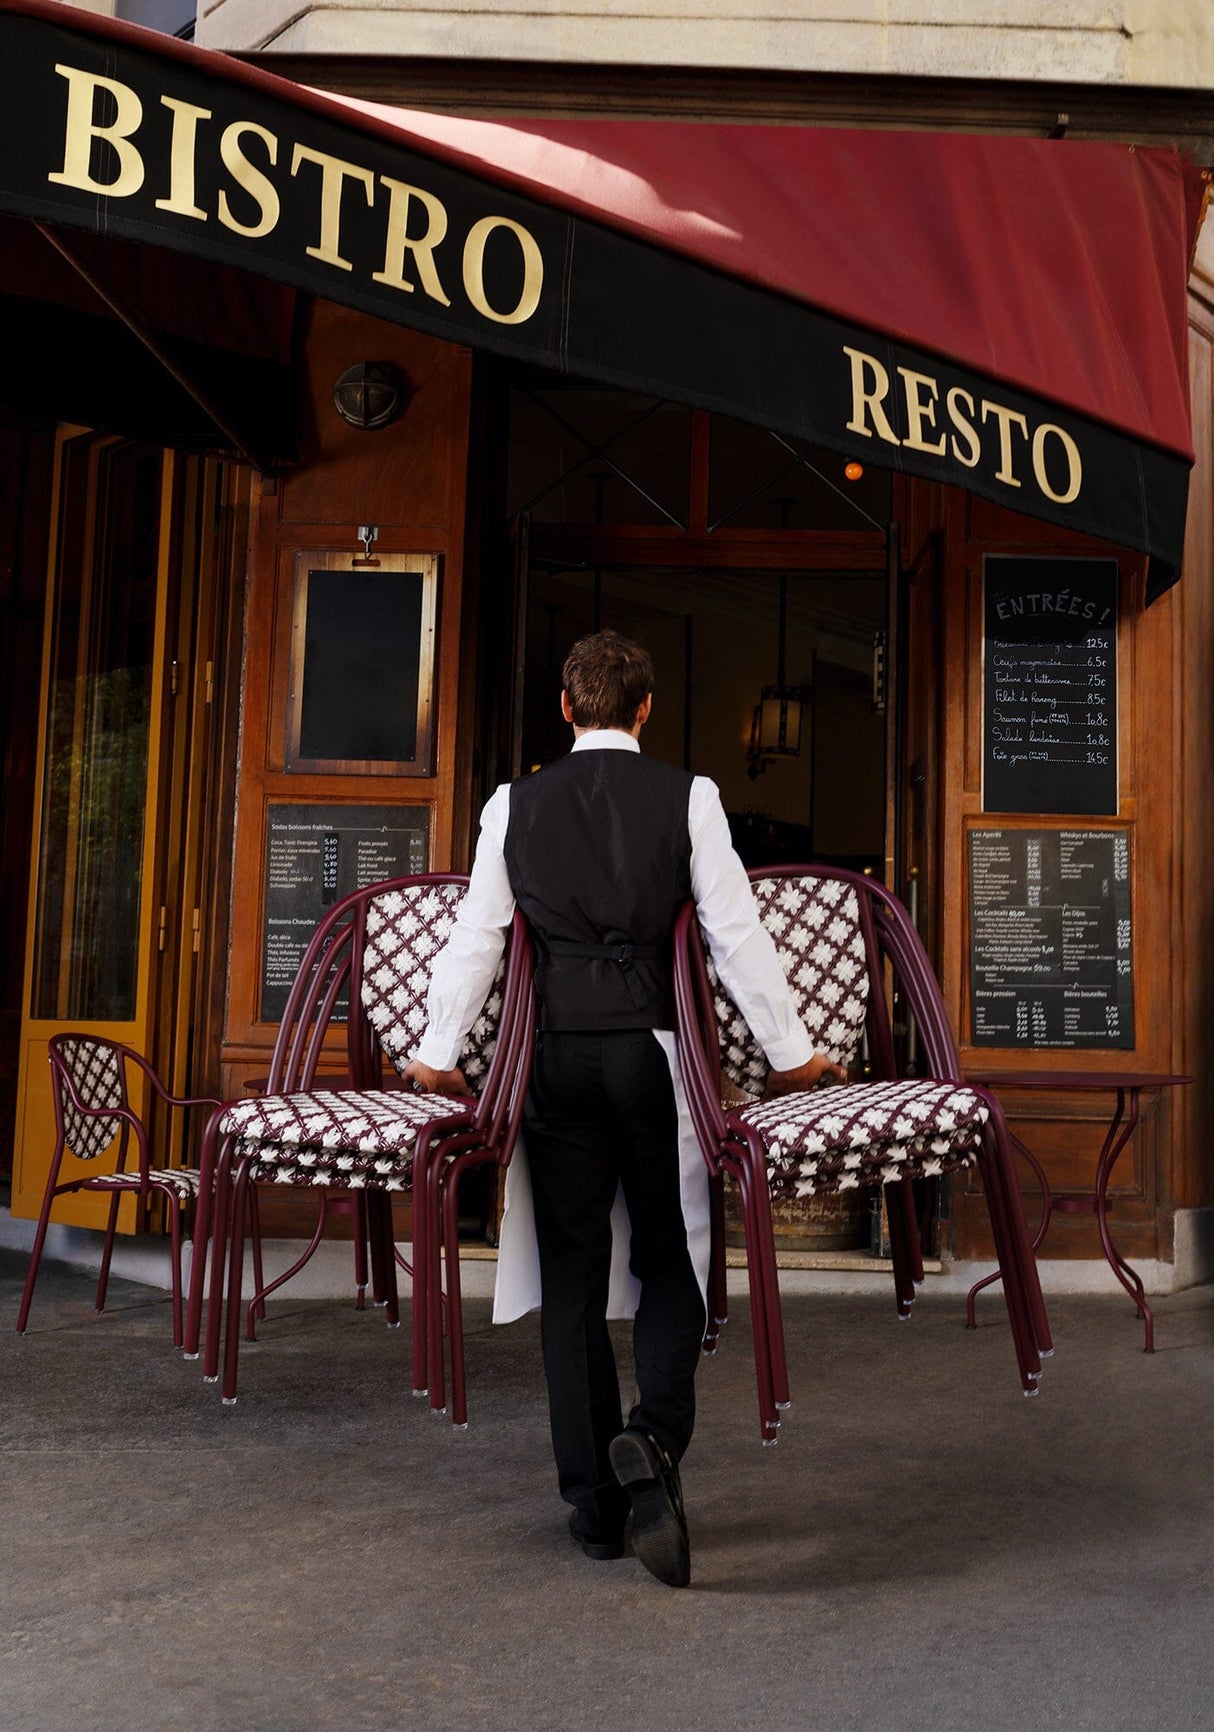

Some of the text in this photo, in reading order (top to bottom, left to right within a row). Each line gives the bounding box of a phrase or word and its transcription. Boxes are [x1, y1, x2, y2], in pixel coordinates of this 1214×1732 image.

[48, 64, 1083, 505] BISTRO RESTO
[999, 963, 1033, 973] Champagne
